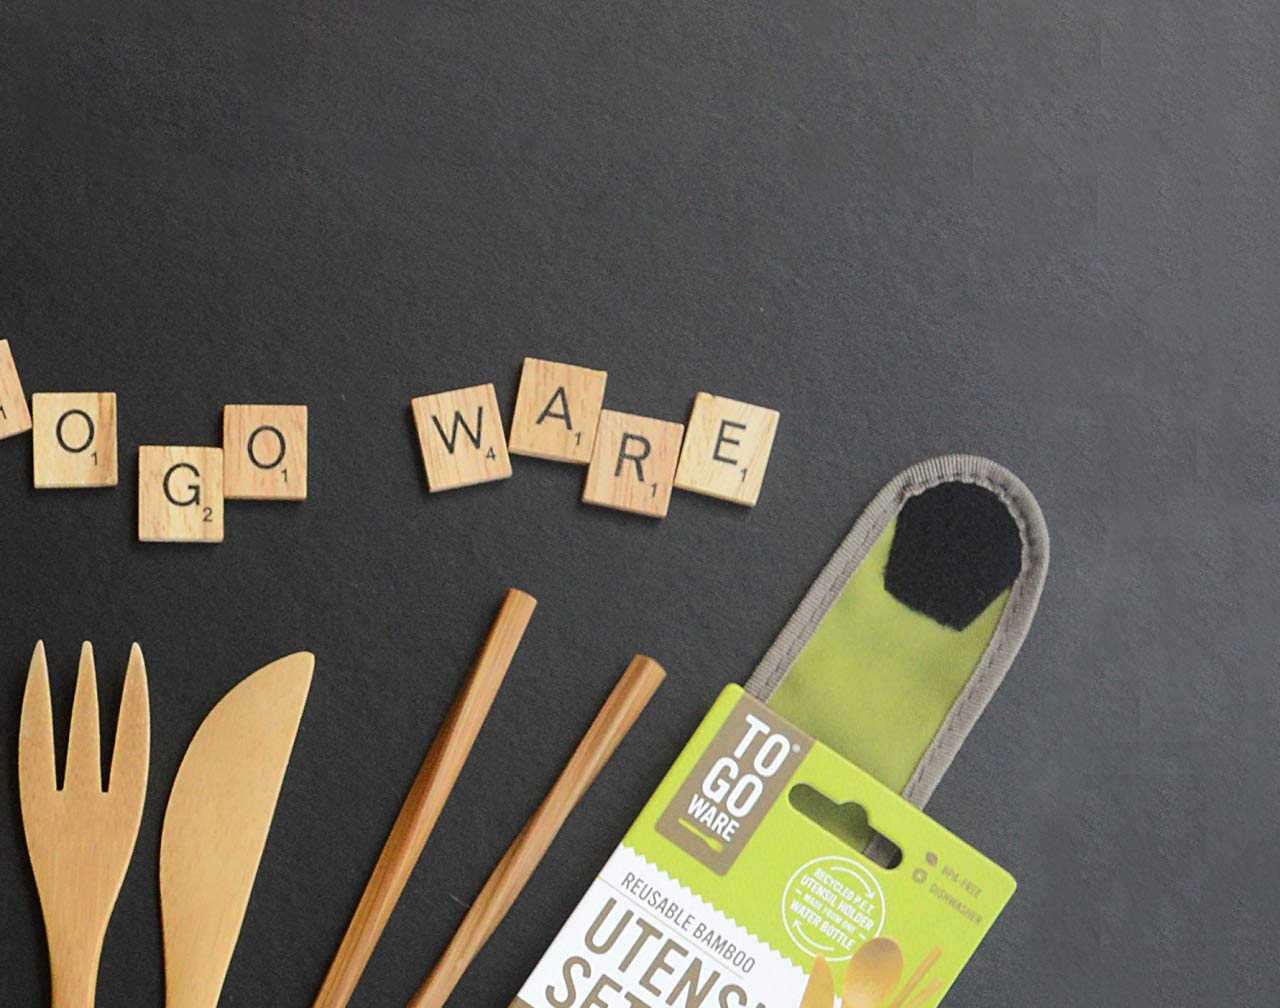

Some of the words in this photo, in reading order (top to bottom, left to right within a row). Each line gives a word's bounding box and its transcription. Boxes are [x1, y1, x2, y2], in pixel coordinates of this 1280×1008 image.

[430, 386, 747, 482] WARE
[733, 713, 791, 777] TO
[687, 793, 740, 842] WARE
[702, 757, 763, 818] GO
[621, 872, 696, 931] REUSABLE
[692, 922, 756, 974] BAMBOO
[790, 898, 822, 927] WATER
[820, 921, 856, 950] BOTTLE
[801, 874, 838, 907] UTENSIL
[837, 900, 874, 931] HOLDER
